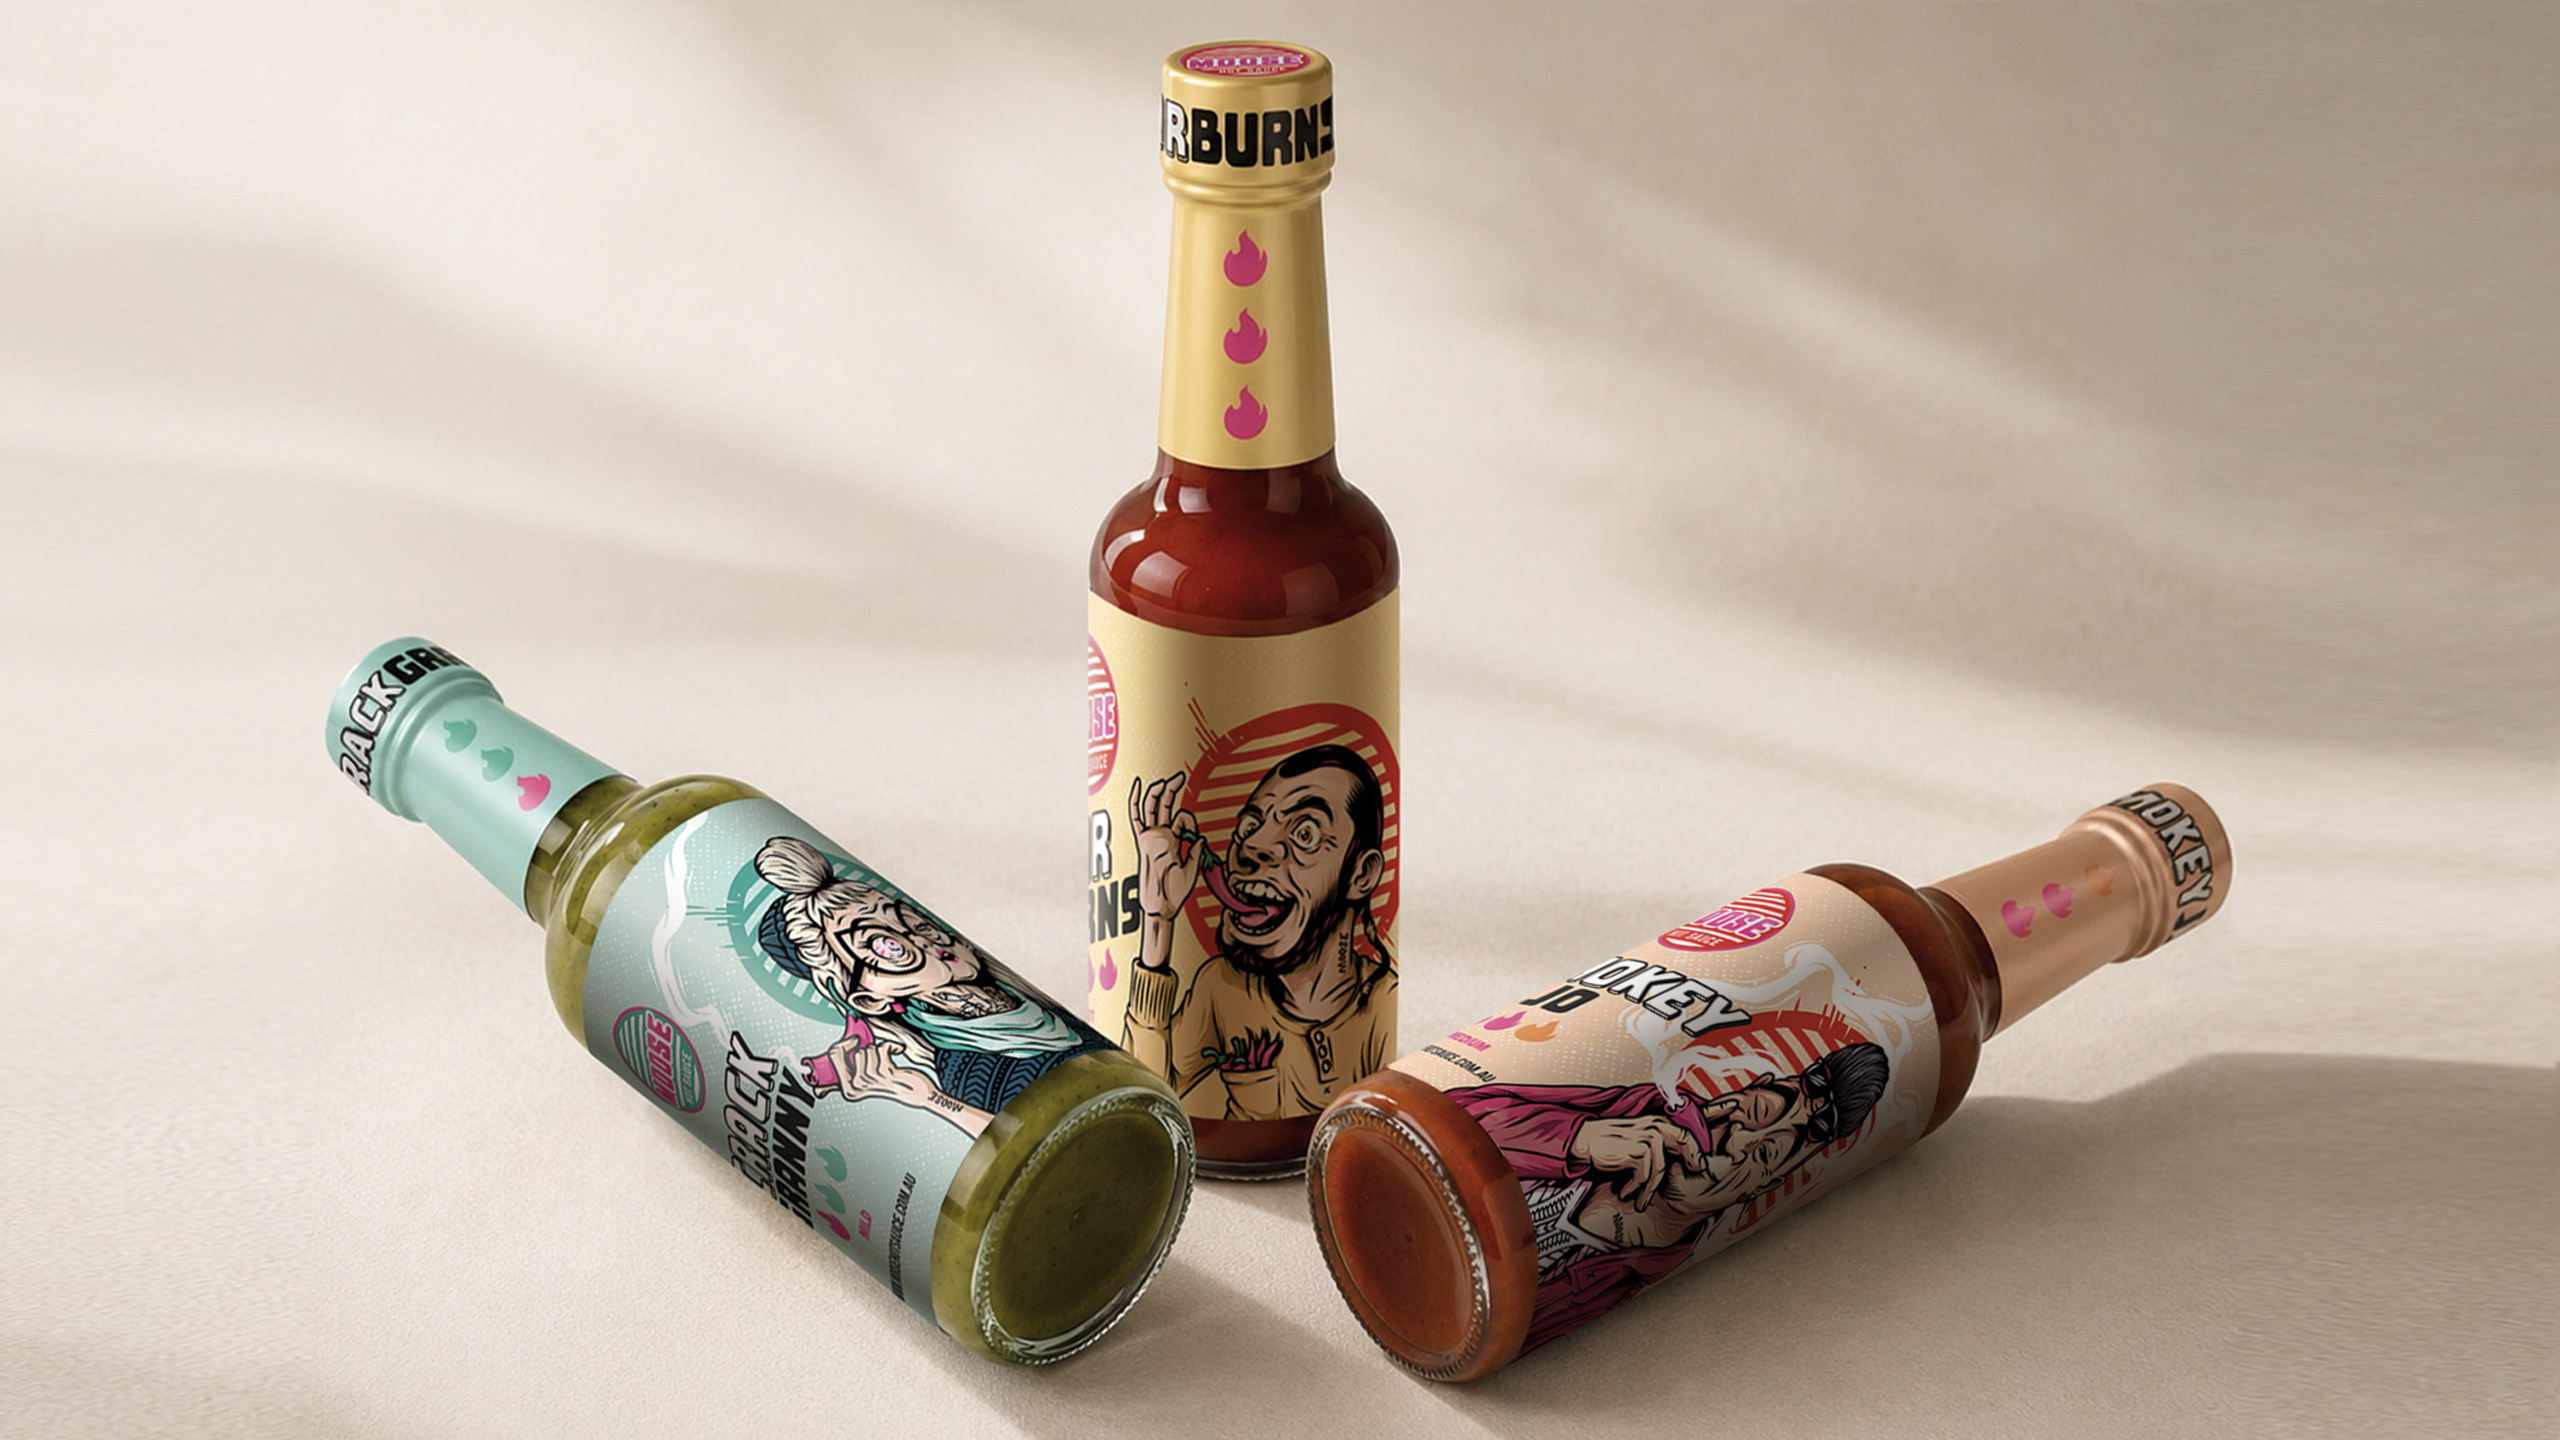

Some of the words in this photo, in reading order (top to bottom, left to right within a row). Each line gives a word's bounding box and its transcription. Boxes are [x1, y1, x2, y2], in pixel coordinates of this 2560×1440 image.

[1186, 54, 1304, 69] MOOSE
[1338, 932, 1349, 973] MOOSE
[1519, 985, 1600, 1014] JO
[1566, 956, 1752, 1038] OKEY
[645, 1009, 680, 1109] MOOSE
[928, 1090, 964, 1112] MOOSE
